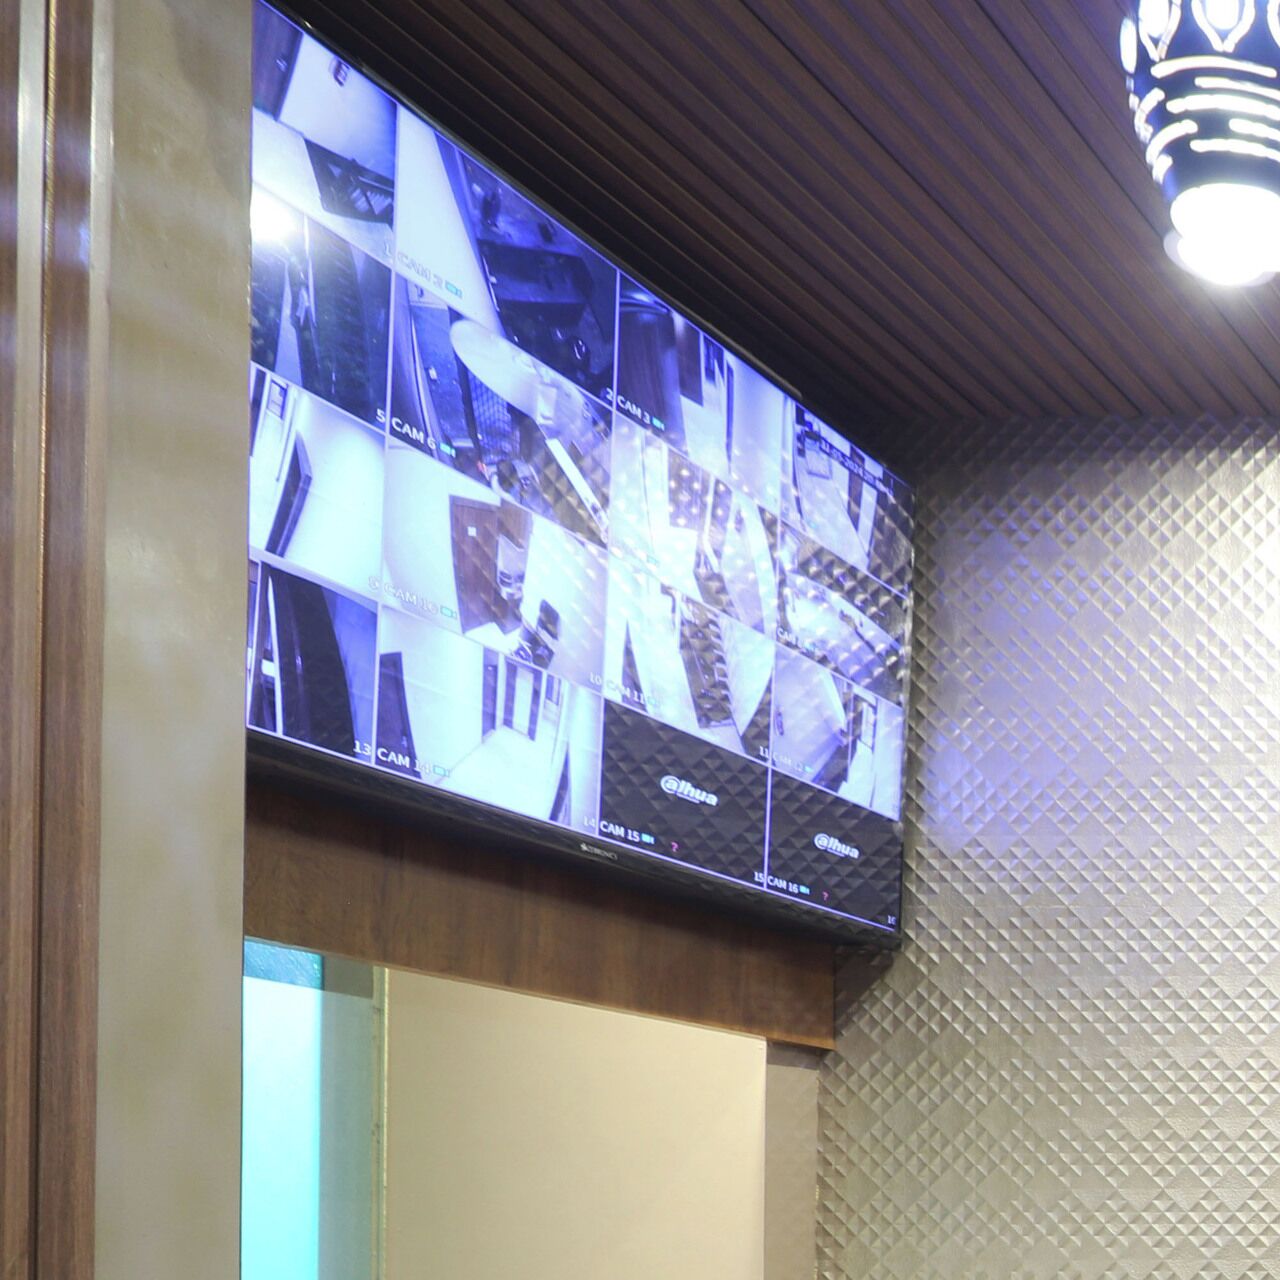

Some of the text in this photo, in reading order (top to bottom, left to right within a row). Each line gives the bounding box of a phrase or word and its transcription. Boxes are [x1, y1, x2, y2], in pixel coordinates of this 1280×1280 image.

[376, 409, 386, 423] 5
[617, 395, 642, 419] CAM
[391, 418, 437, 449] CAM 6
[353, 740, 371, 755] 13
[377, 748, 410, 768] CAM
[600, 821, 640, 843] CAM 15
[767, 875, 799, 894] CAM 16
